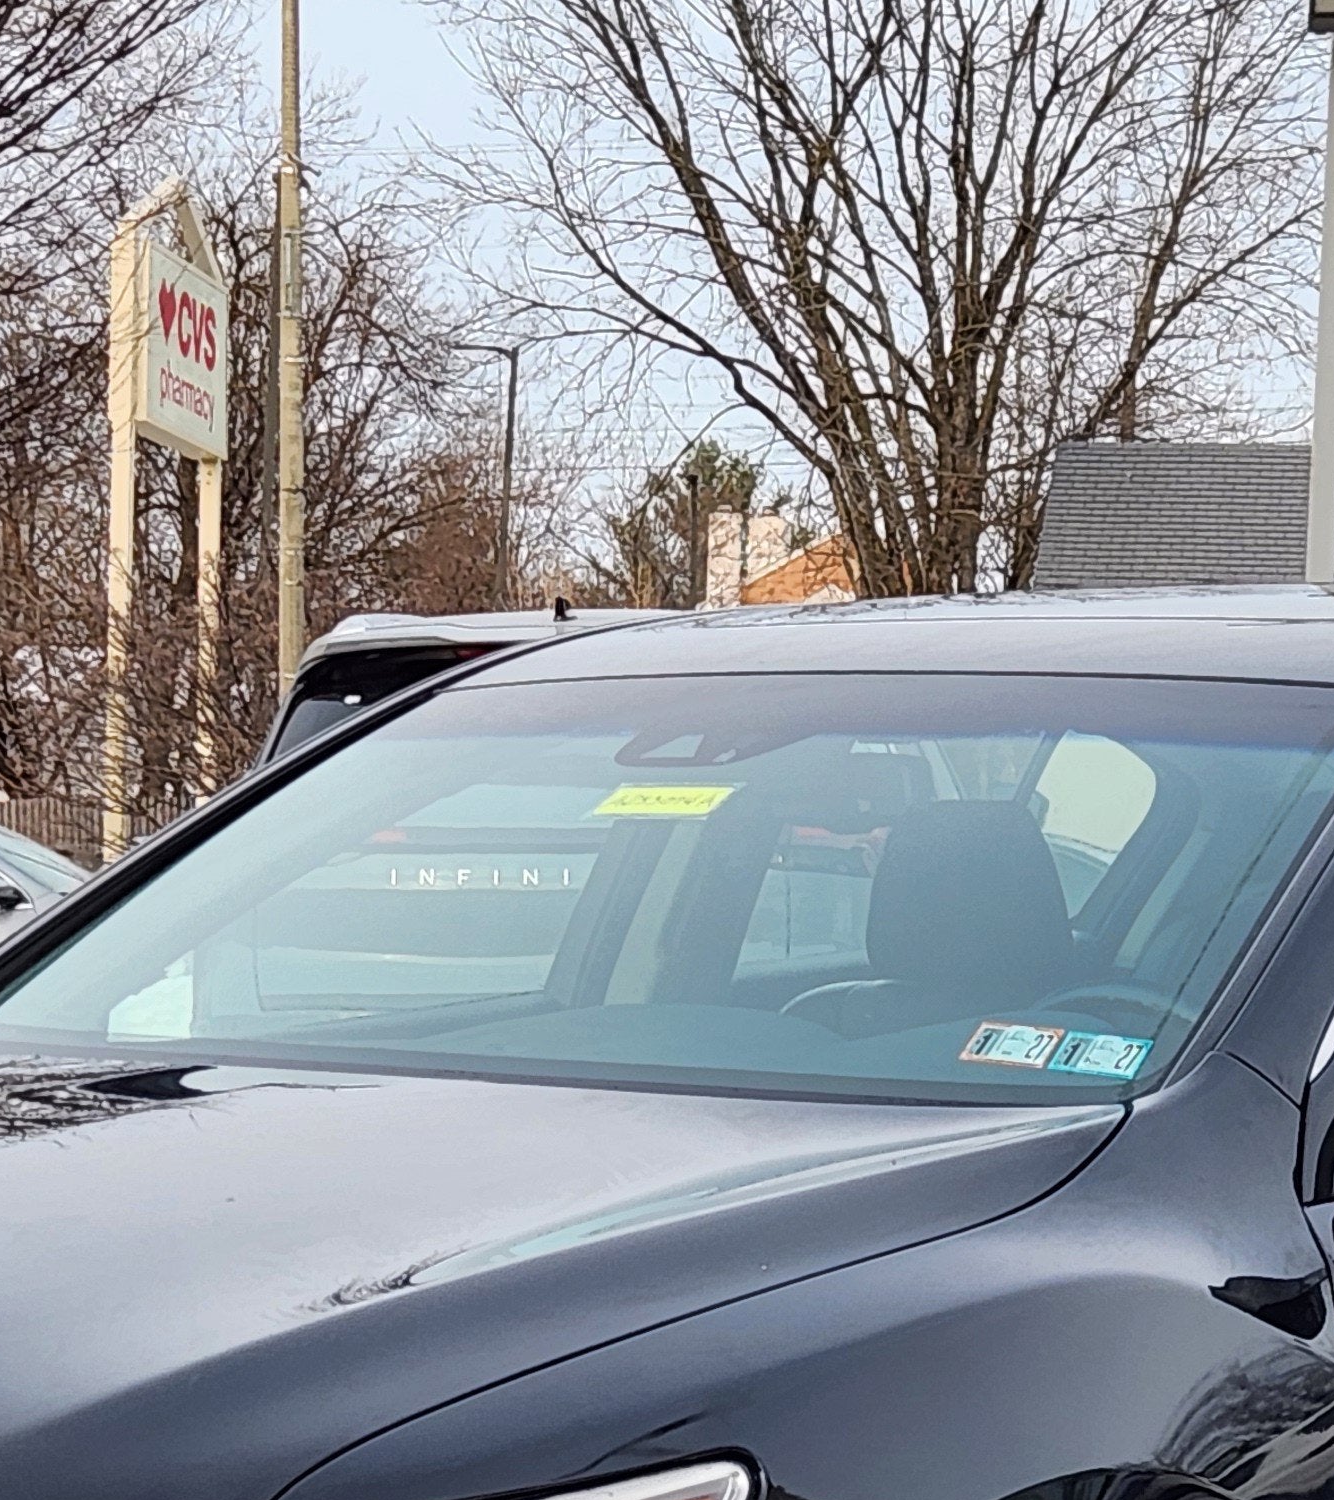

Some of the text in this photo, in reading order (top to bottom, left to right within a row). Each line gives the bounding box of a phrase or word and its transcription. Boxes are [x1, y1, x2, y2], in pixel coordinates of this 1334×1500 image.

[177, 291, 217, 372] CVS
[390, 867, 570, 886] INFINI
[1024, 1033, 1054, 1063] 27
[1114, 1043, 1145, 1072] 27
